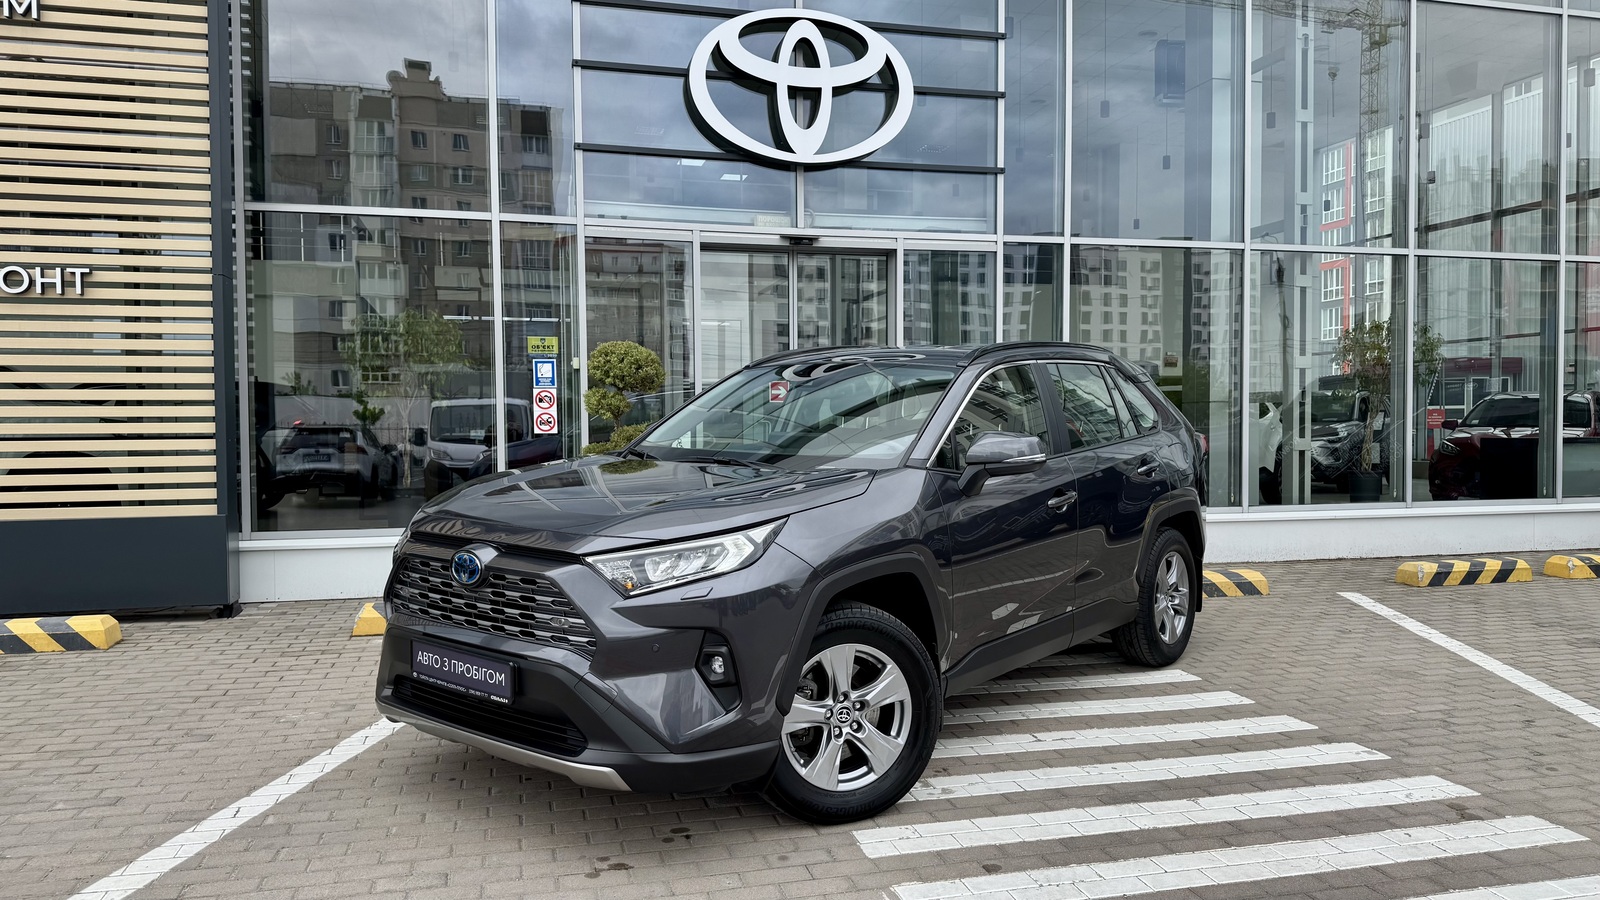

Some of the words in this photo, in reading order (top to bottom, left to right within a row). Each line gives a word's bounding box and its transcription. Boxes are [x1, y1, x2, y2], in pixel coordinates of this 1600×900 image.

[0, 265, 90, 295] ОНТ
[417, 650, 441, 668] АВТО
[451, 659, 505, 687] ПРОБІГОМ
